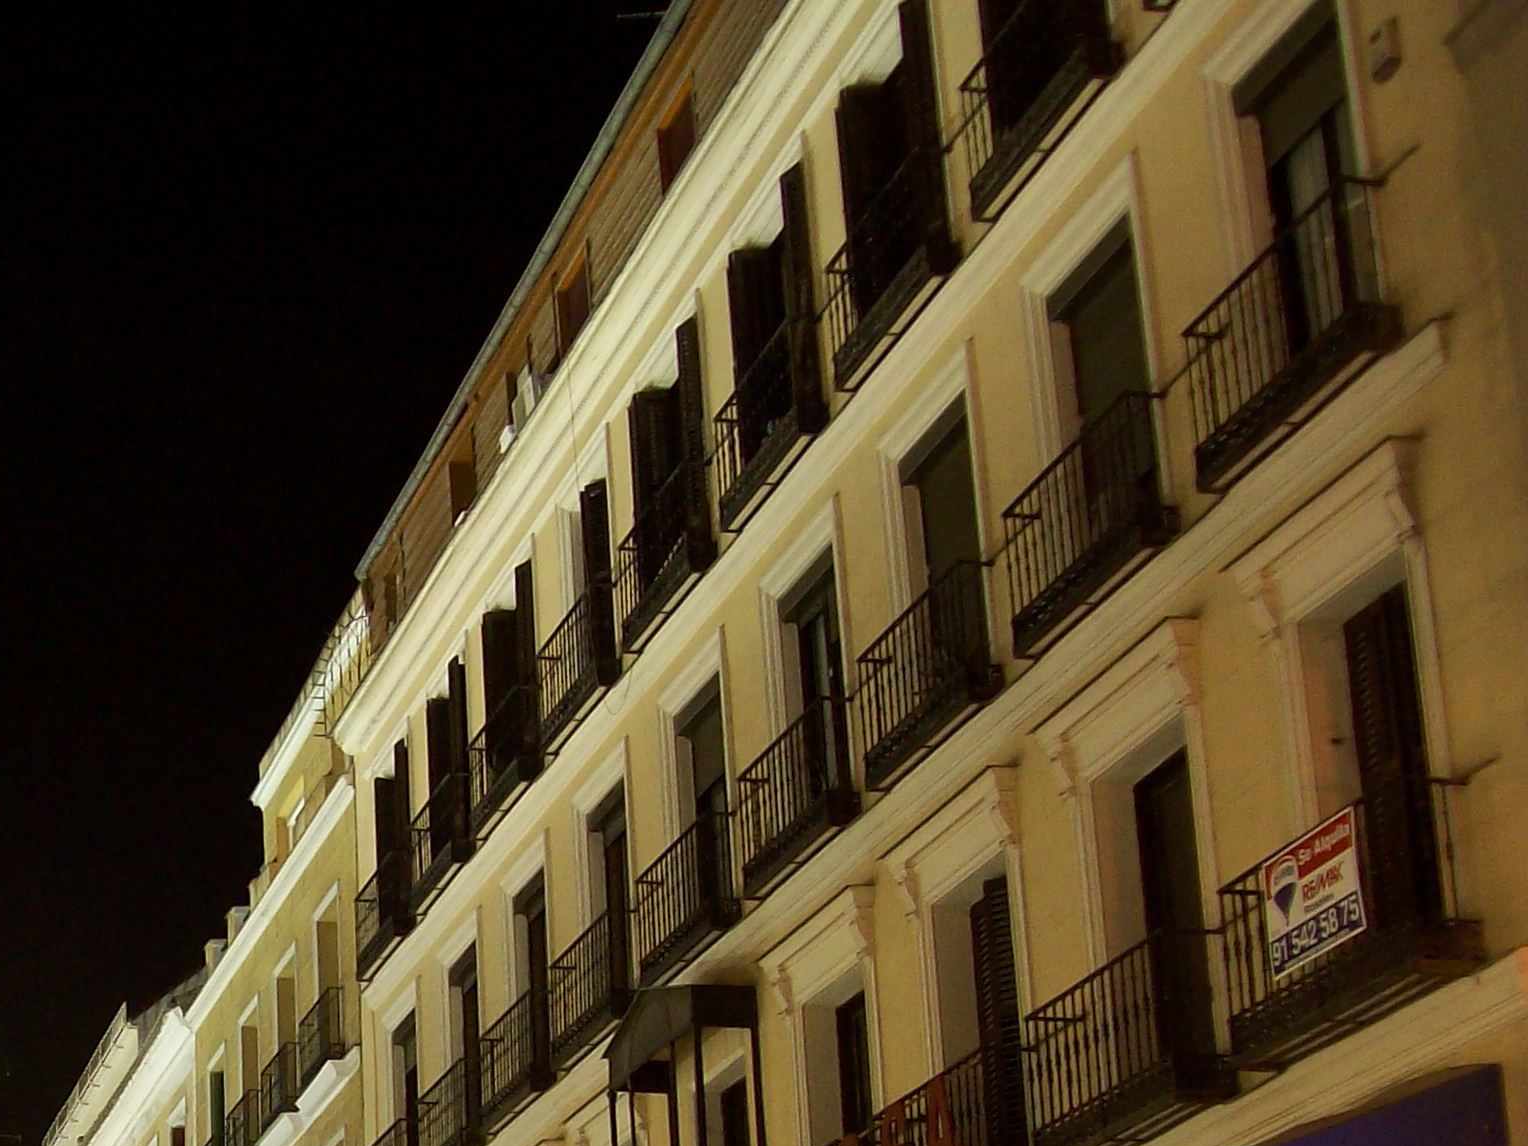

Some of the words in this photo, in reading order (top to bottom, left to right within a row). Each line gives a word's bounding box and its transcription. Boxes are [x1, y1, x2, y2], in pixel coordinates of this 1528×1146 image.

[1273, 941, 1289, 967] 91
[1292, 919, 1317, 954] 542
[1321, 907, 1338, 935] 58
[1341, 896, 1360, 925] 75
